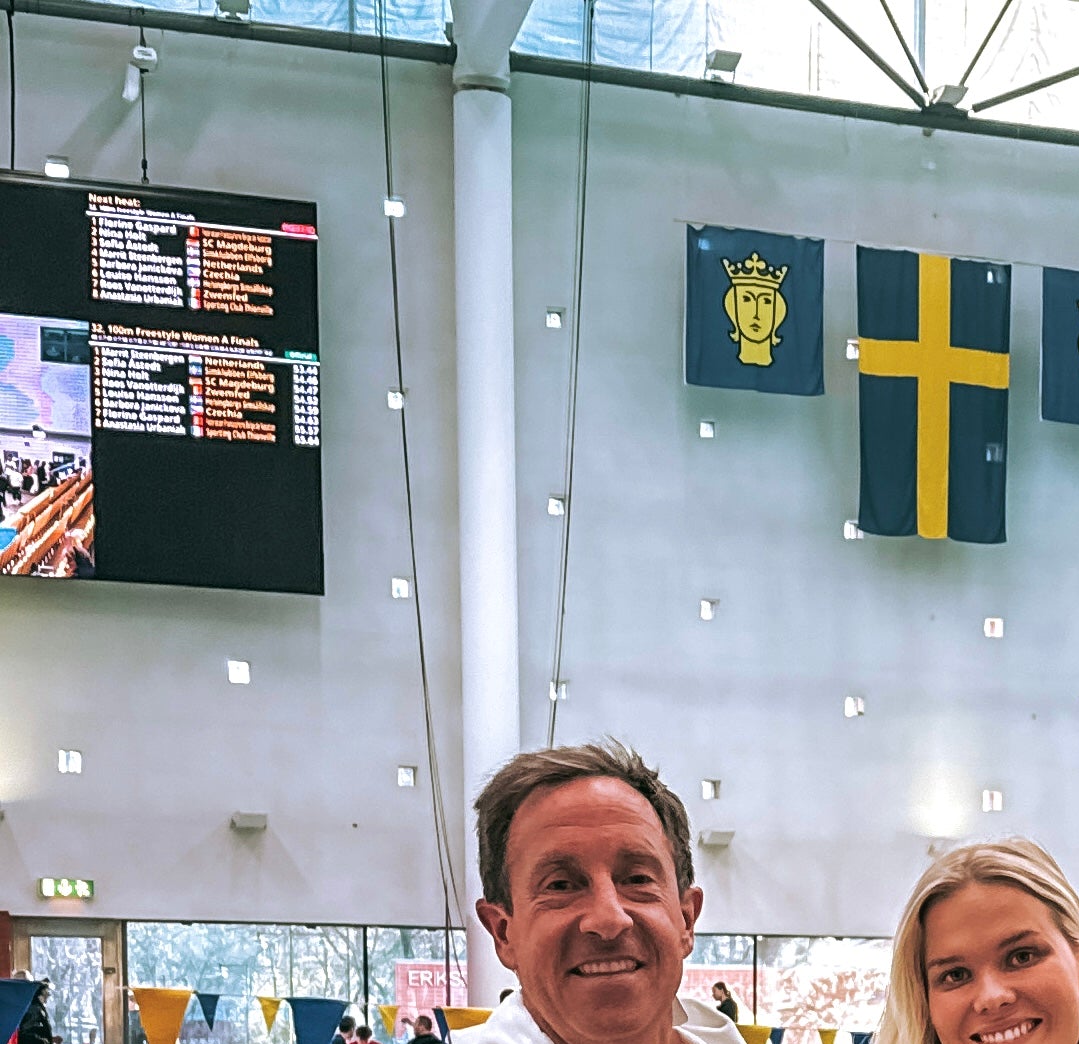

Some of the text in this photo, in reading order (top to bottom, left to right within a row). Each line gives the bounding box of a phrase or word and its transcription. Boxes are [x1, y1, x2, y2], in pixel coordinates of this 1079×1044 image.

[108, 324, 134, 336] 100m
[136, 326, 180, 340] Freestyle
[182, 331, 220, 342] Women
[222, 334, 229, 344] A
[230, 336, 260, 348] Finals
[205, 357, 264, 370] Netherlands
